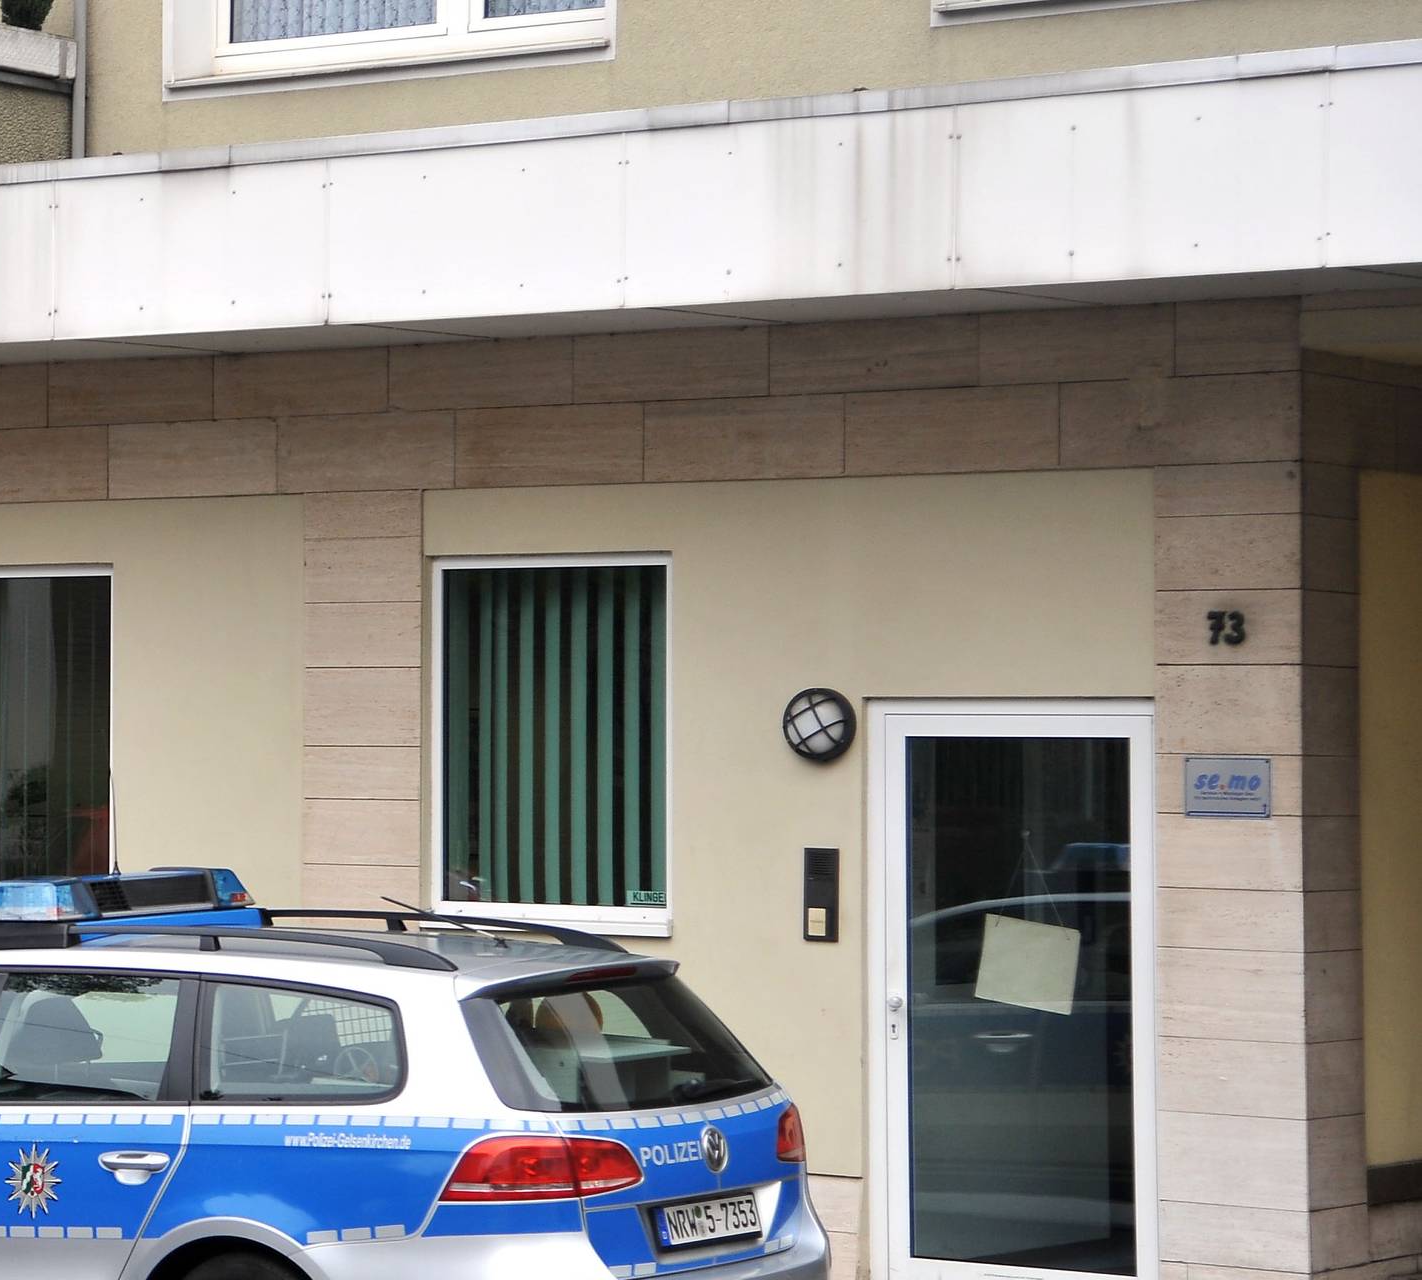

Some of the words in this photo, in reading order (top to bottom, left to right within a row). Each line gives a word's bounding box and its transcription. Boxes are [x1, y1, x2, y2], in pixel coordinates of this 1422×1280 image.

[1207, 610, 1246, 646] 73
[1194, 773, 1261, 791] se.mo
[284, 1132, 411, 1150] www.Polizei-Gelsenkirchen.de
[640, 1140, 703, 1168] POLIZEI
[667, 1208, 698, 1240] NRW
[703, 1199, 757, 1233] 5-7353
